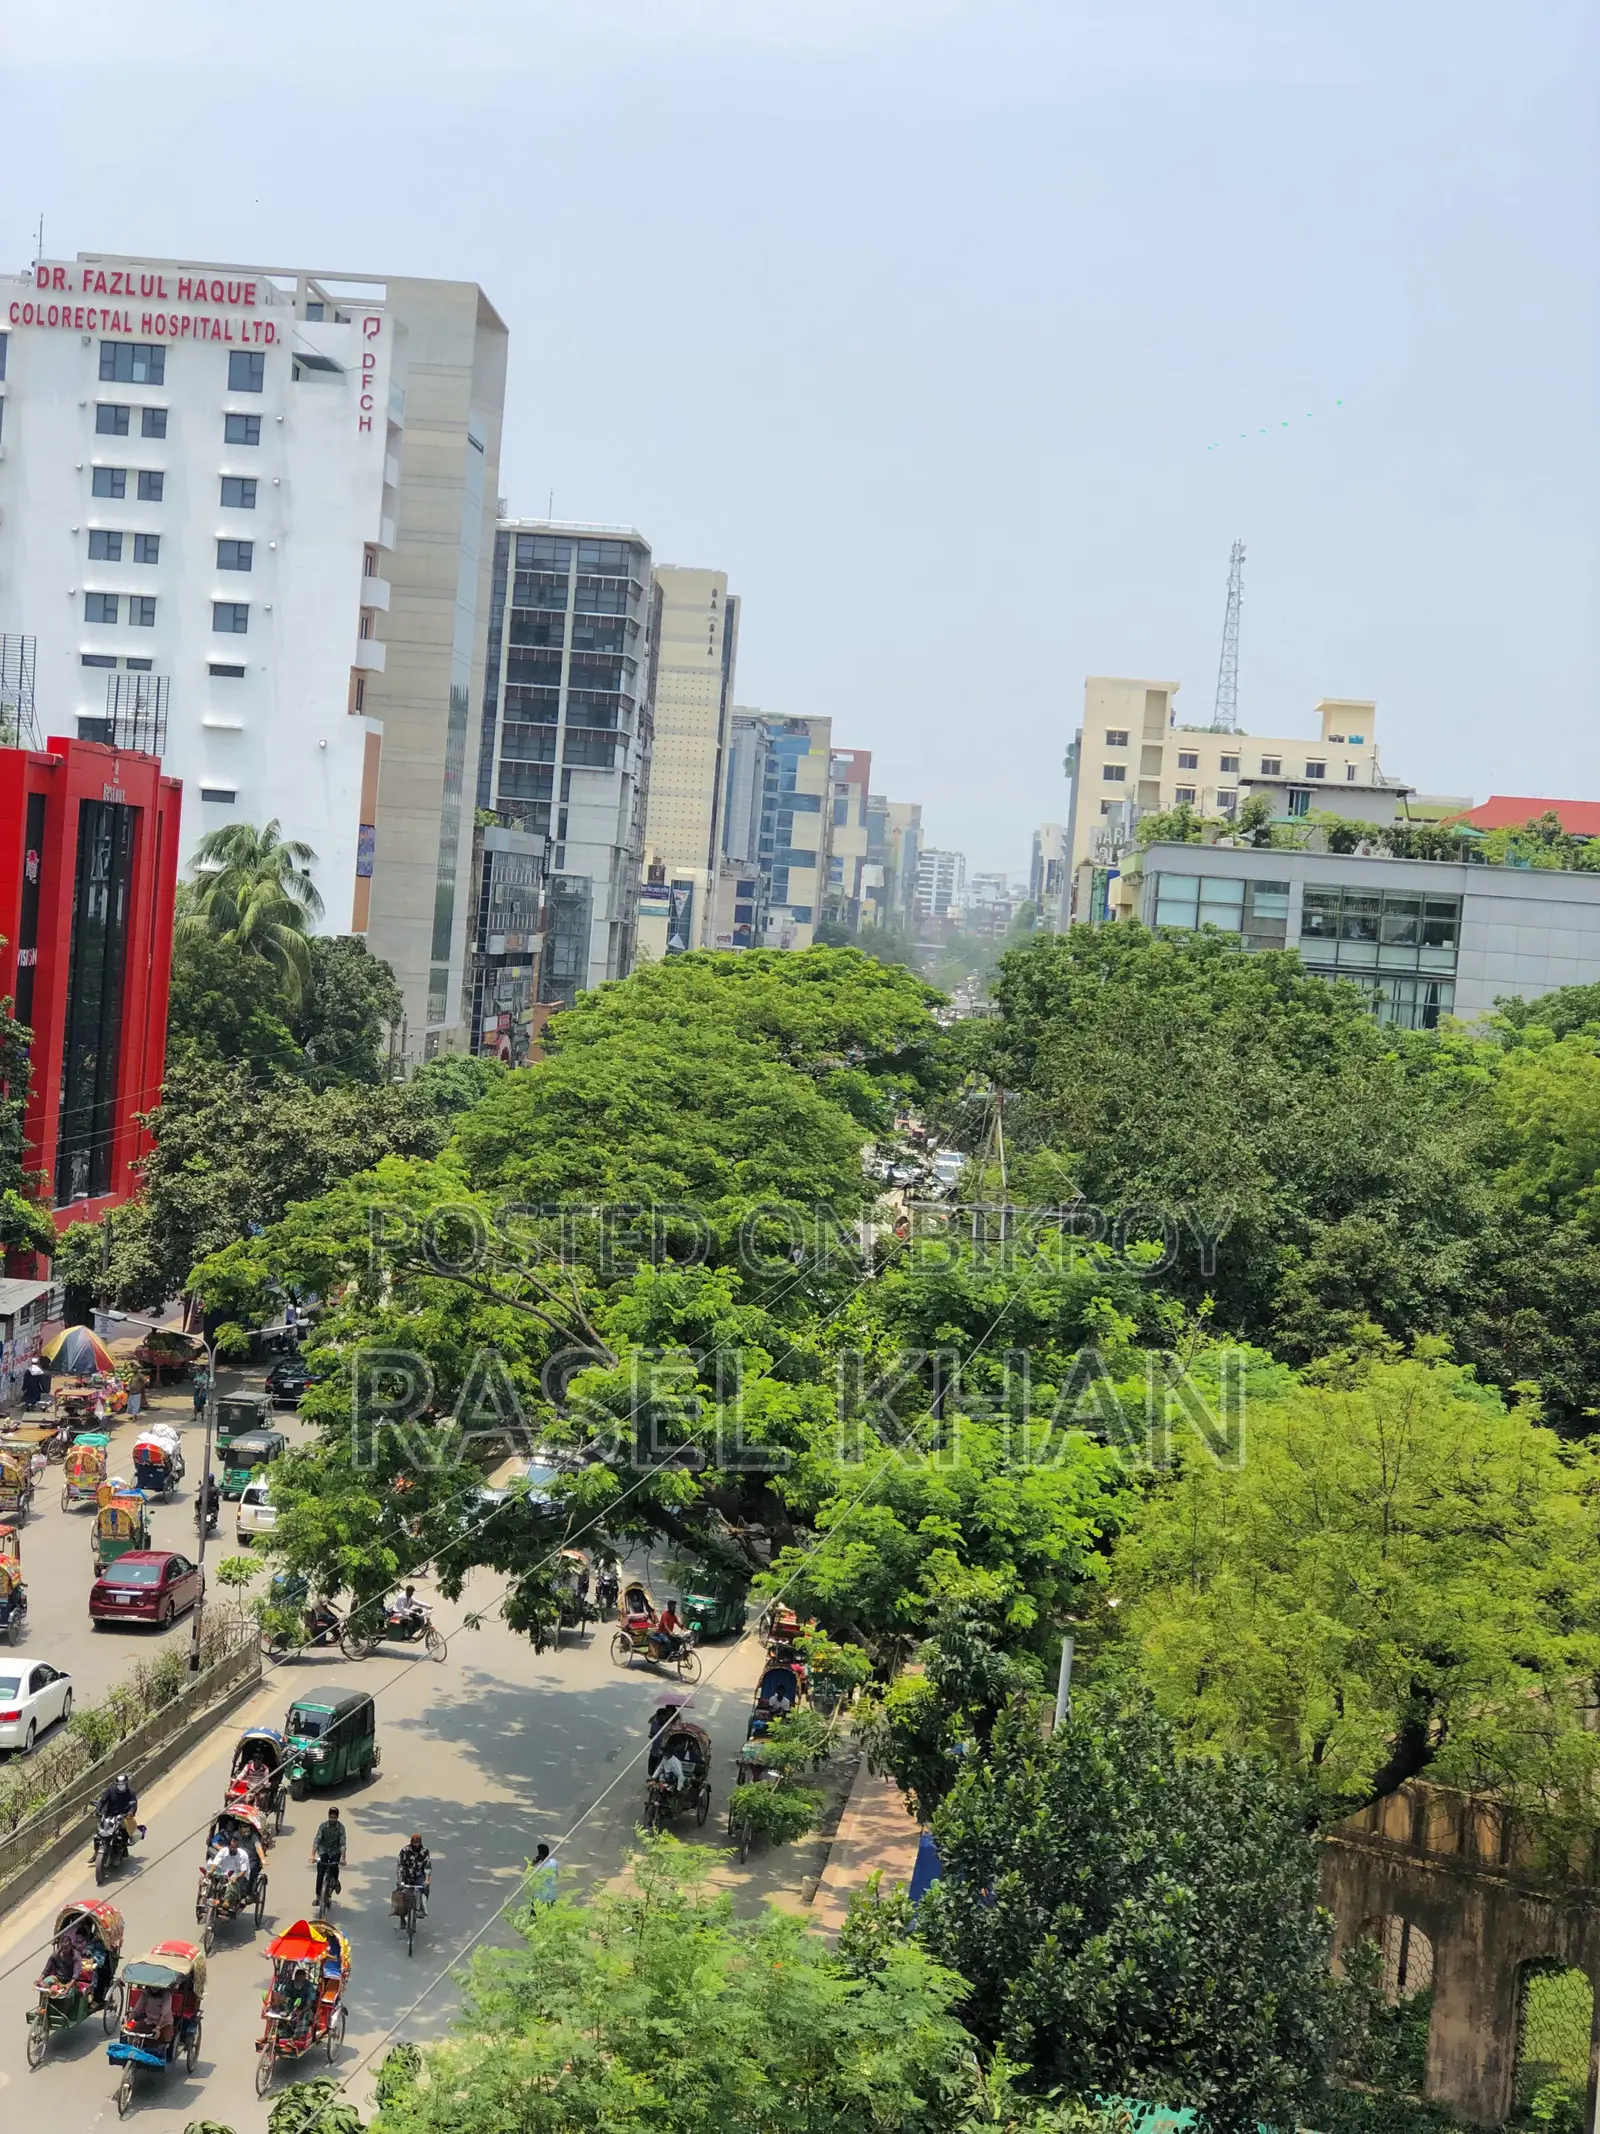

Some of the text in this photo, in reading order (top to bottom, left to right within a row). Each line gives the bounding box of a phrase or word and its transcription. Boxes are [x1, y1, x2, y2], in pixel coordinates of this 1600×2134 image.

[36, 265, 256, 305] DR. FAZLUL HAQUE
[9, 301, 281, 345] COLORECTAL HOSPITAL LTD.
[17, 948, 38, 967] VISION
